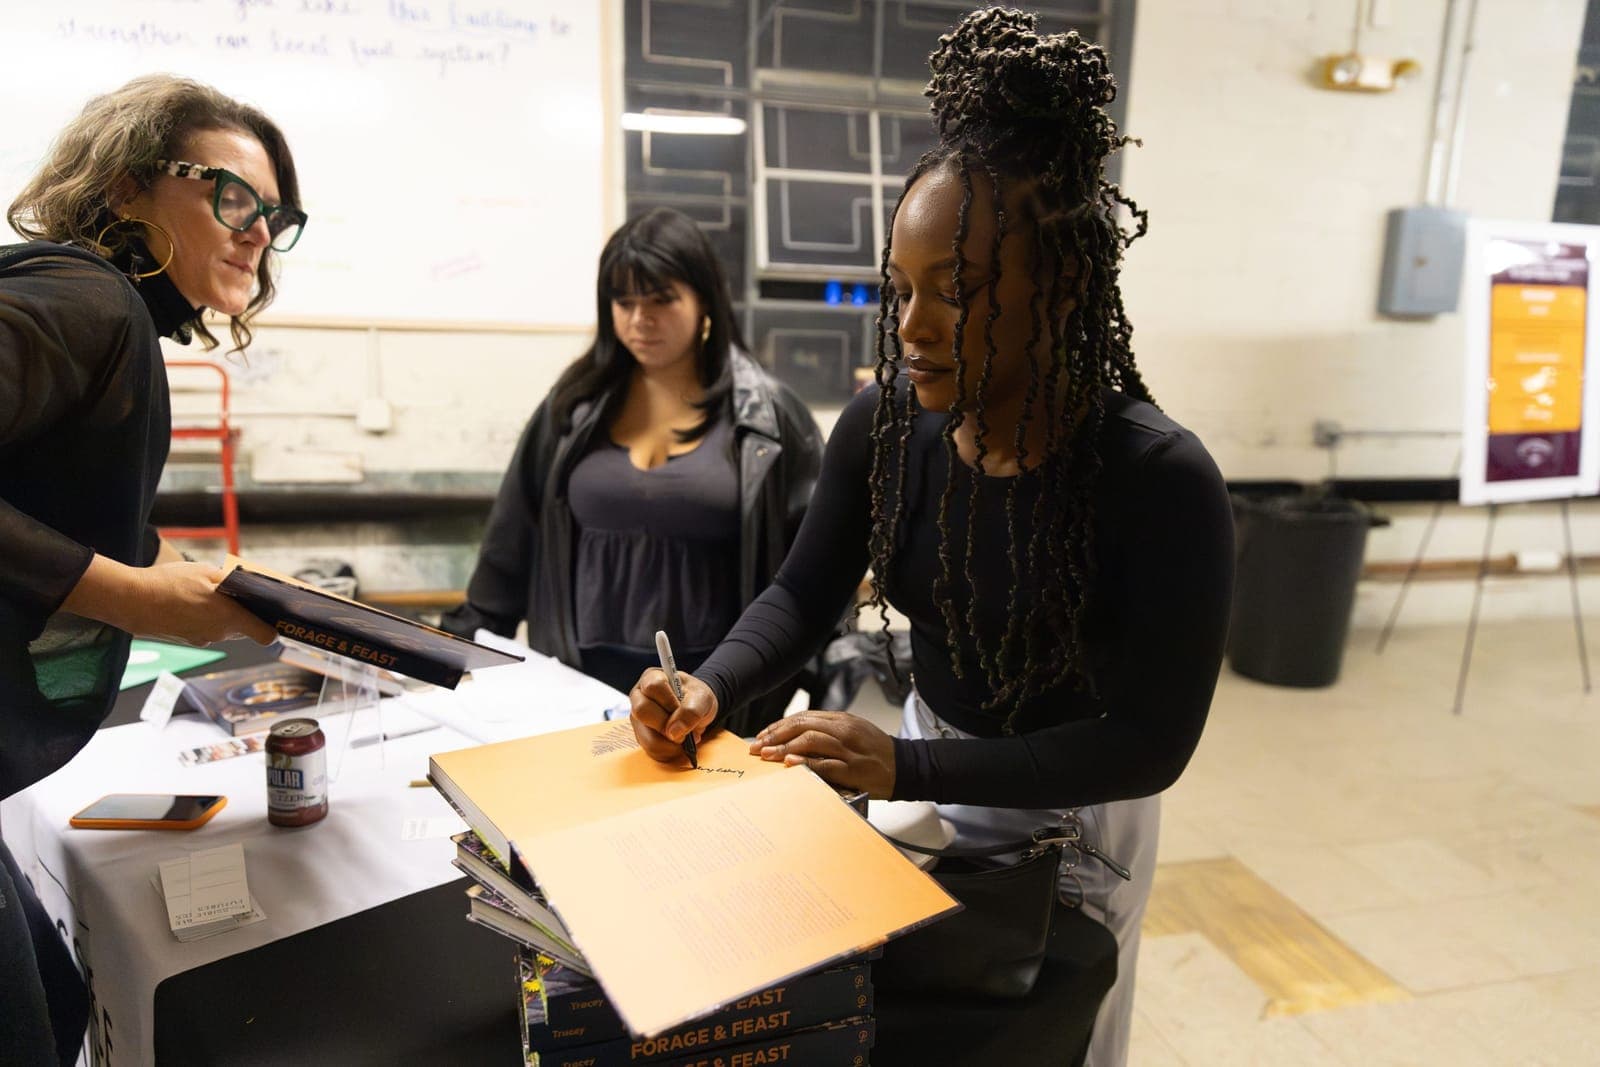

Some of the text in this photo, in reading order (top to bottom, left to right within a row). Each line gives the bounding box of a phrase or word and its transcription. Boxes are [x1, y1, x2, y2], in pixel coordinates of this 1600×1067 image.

[275, 620, 399, 668] FORAGE & FEAST
[726, 988, 786, 1011] EAST
[631, 1010, 791, 1060] FORAGE & FEAST
[730, 1043, 791, 1067] FEAST
